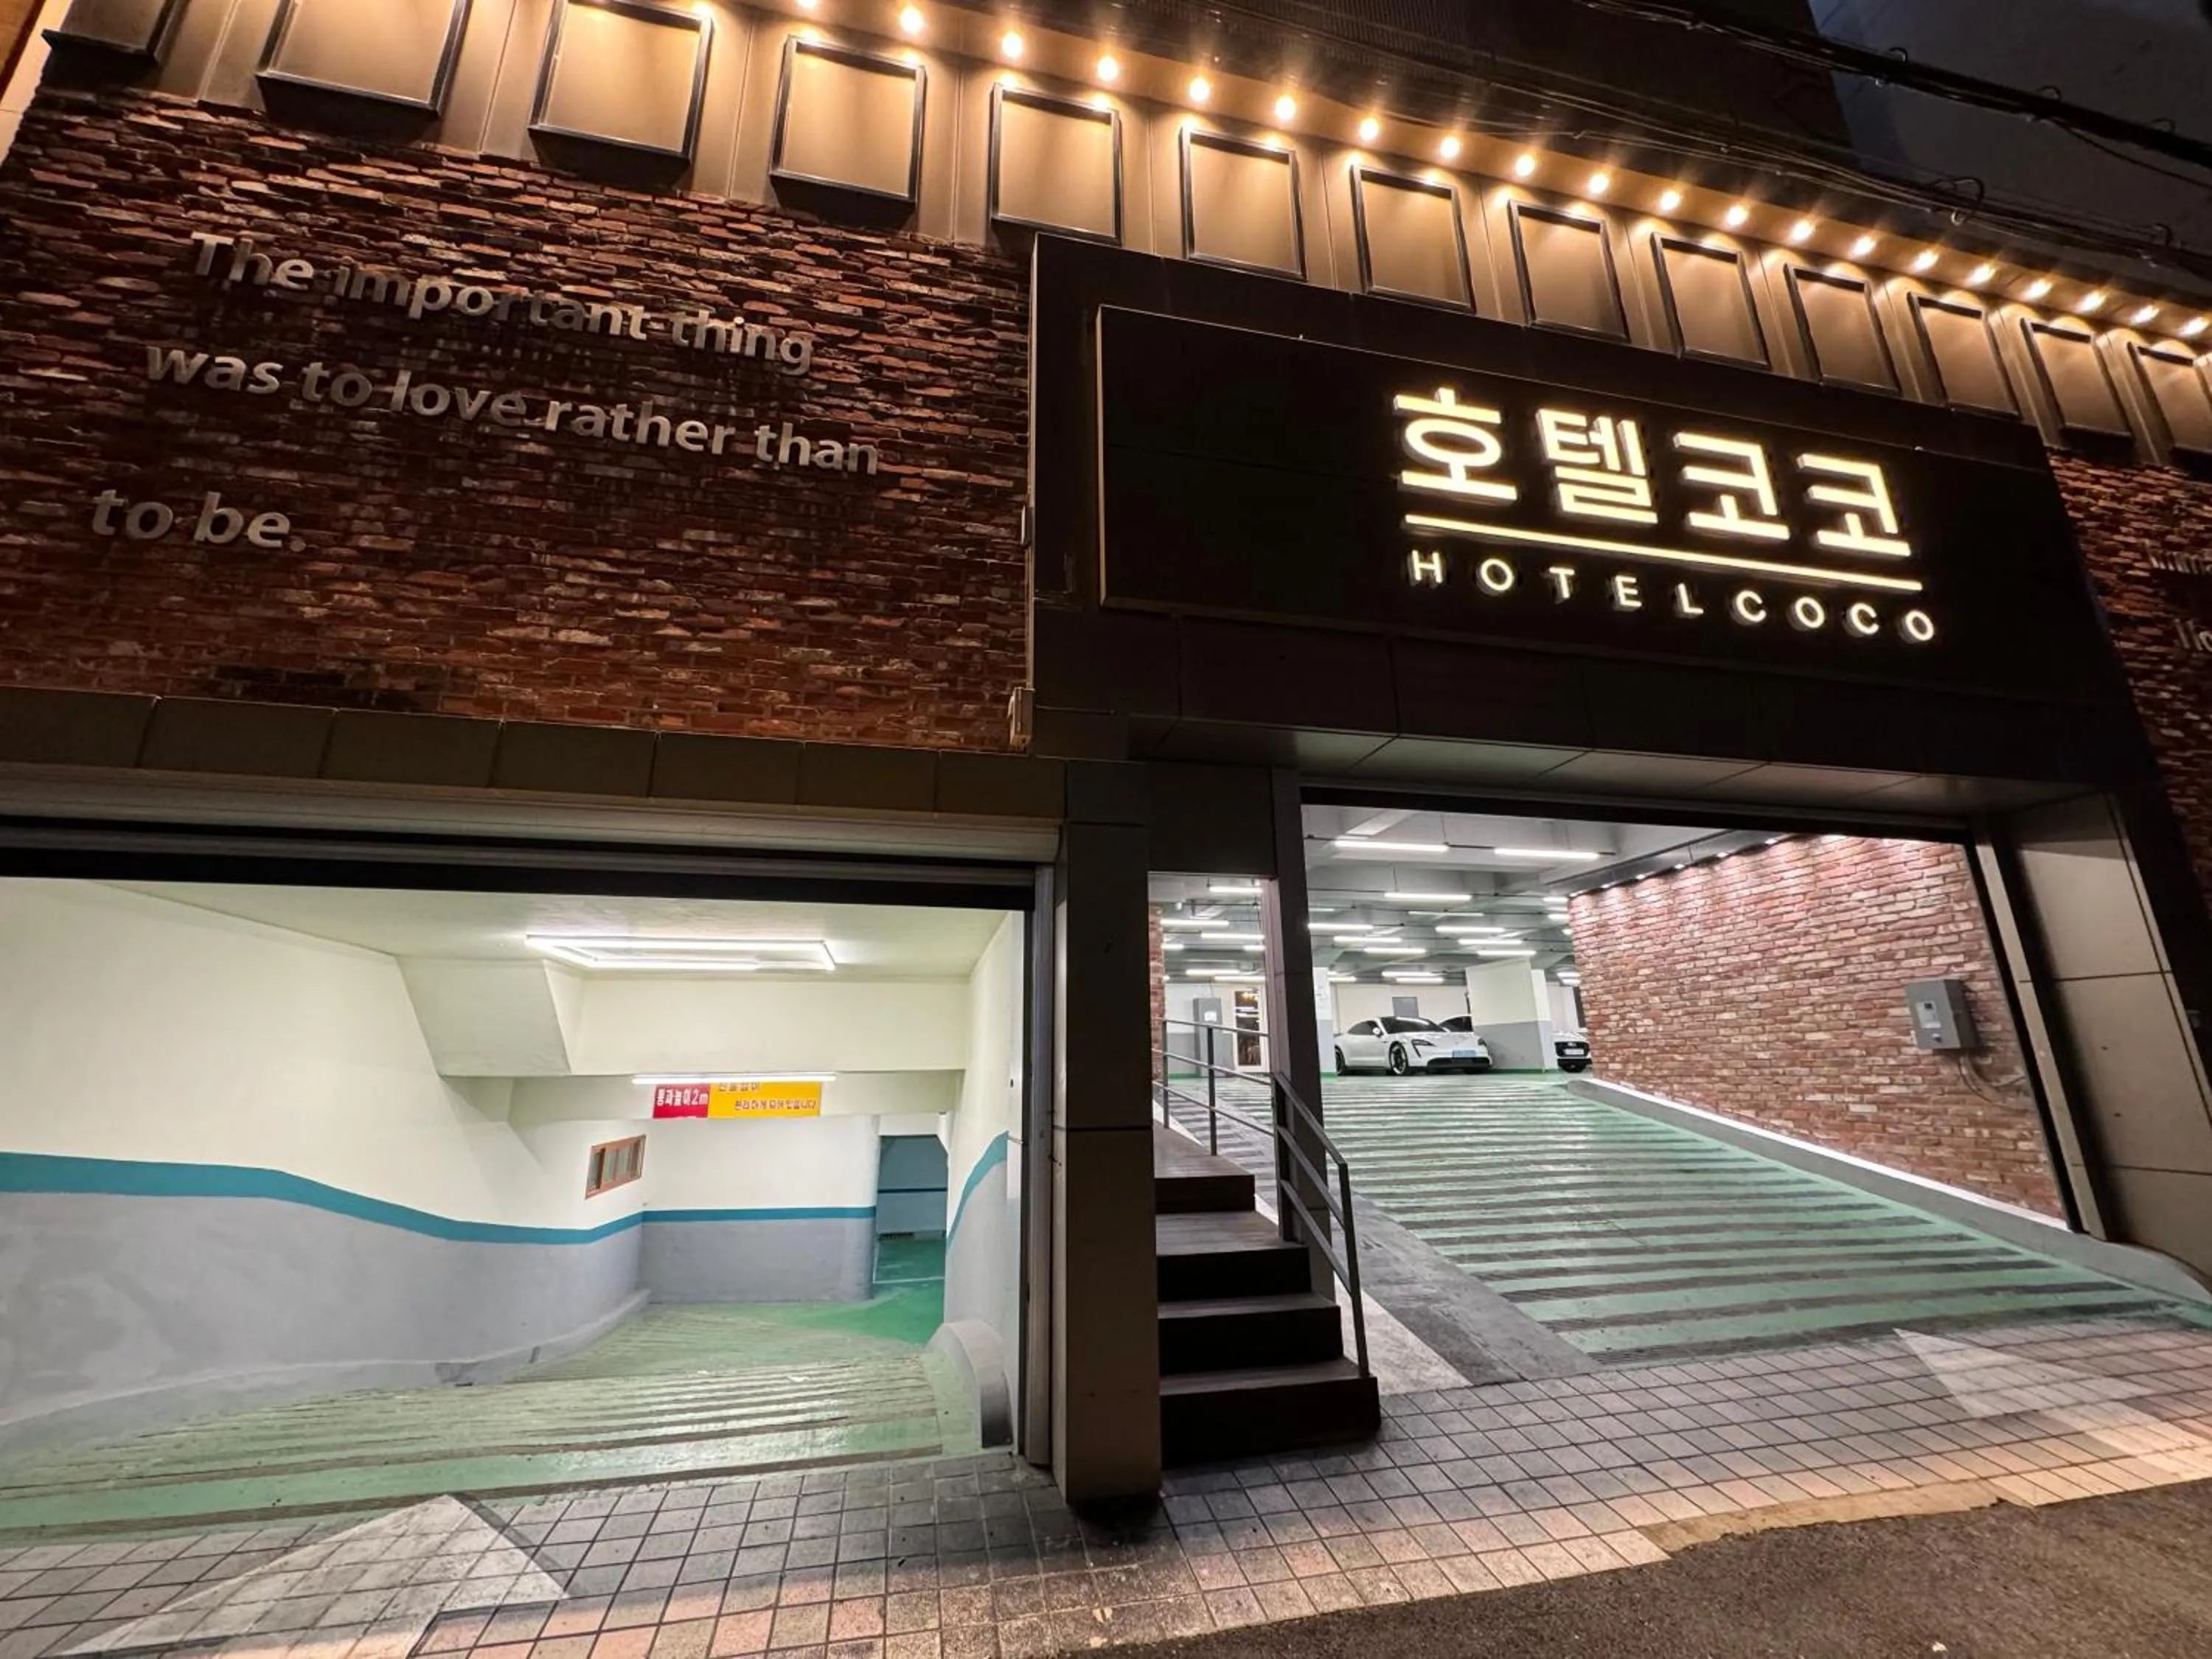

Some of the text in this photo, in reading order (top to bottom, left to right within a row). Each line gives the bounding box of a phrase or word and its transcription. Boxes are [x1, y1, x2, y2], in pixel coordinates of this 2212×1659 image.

[191, 231, 813, 376] The important thing
[147, 345, 878, 476] was to love rather than
[1394, 387, 1912, 557] 호텔코코
[90, 489, 307, 552] to be.
